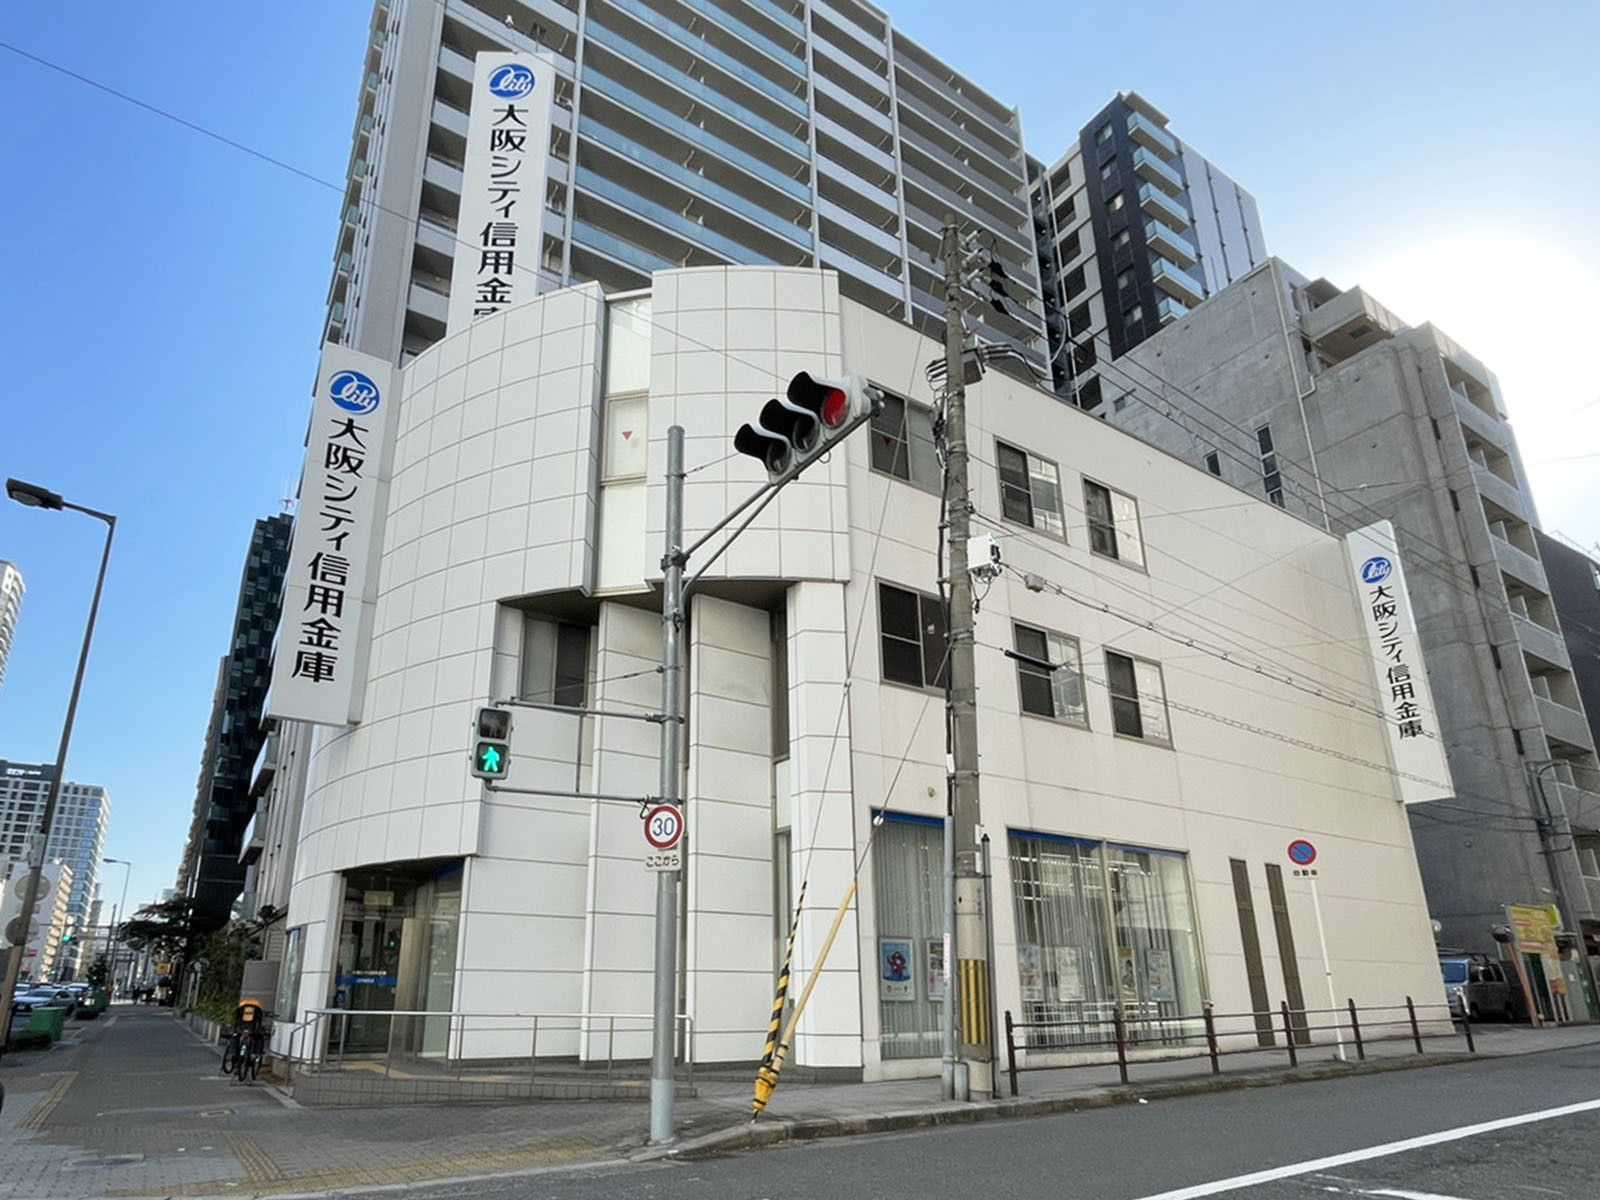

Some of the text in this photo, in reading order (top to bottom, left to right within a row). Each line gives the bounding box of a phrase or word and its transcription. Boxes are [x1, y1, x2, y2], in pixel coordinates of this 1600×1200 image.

[290, 417, 369, 683] 大阪シティ信用金庫
[1369, 585, 1425, 740] 大阪シティ信用金庫
[652, 817, 675, 837] 30
